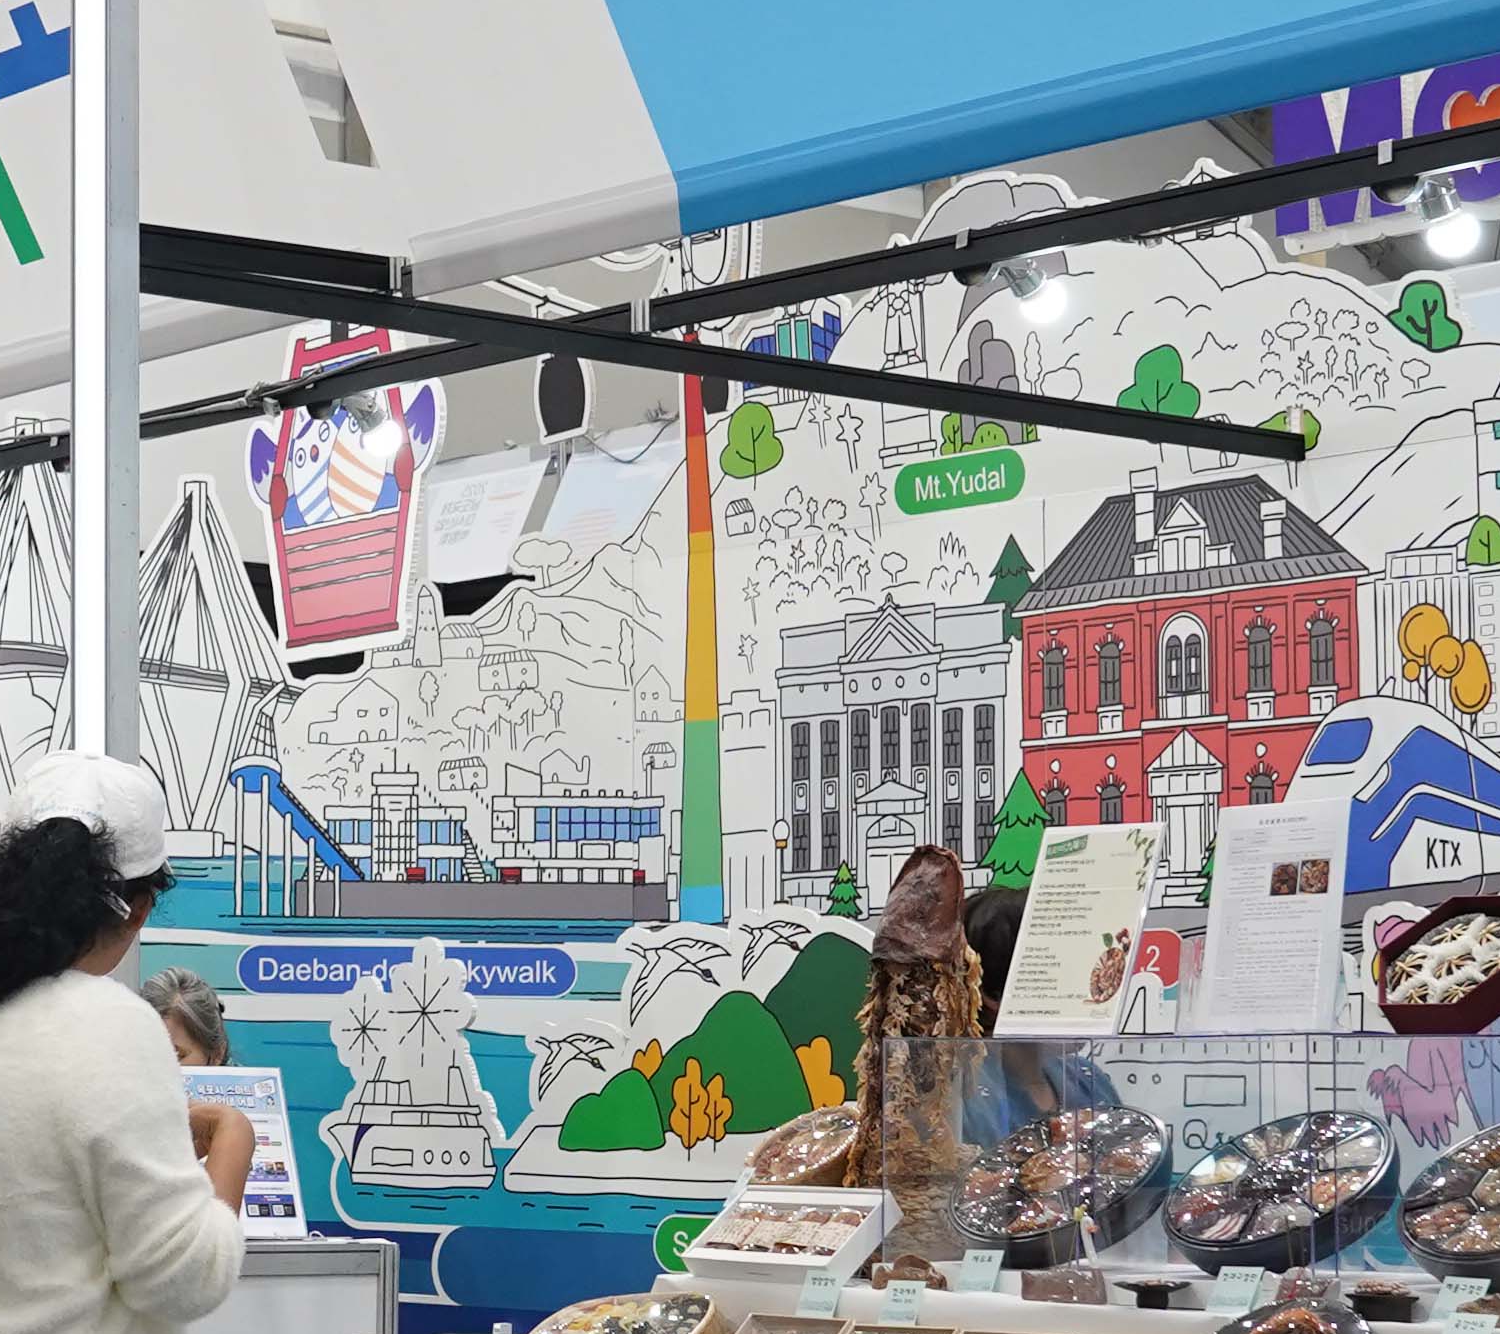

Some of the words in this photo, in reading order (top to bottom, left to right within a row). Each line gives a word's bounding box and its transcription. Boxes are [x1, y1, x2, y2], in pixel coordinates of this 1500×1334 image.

[915, 463, 1006, 502] Mt.Yudal
[1427, 837, 1462, 869] KTX
[257, 957, 397, 983] Daeban-do
[464, 957, 556, 985] kywalk
